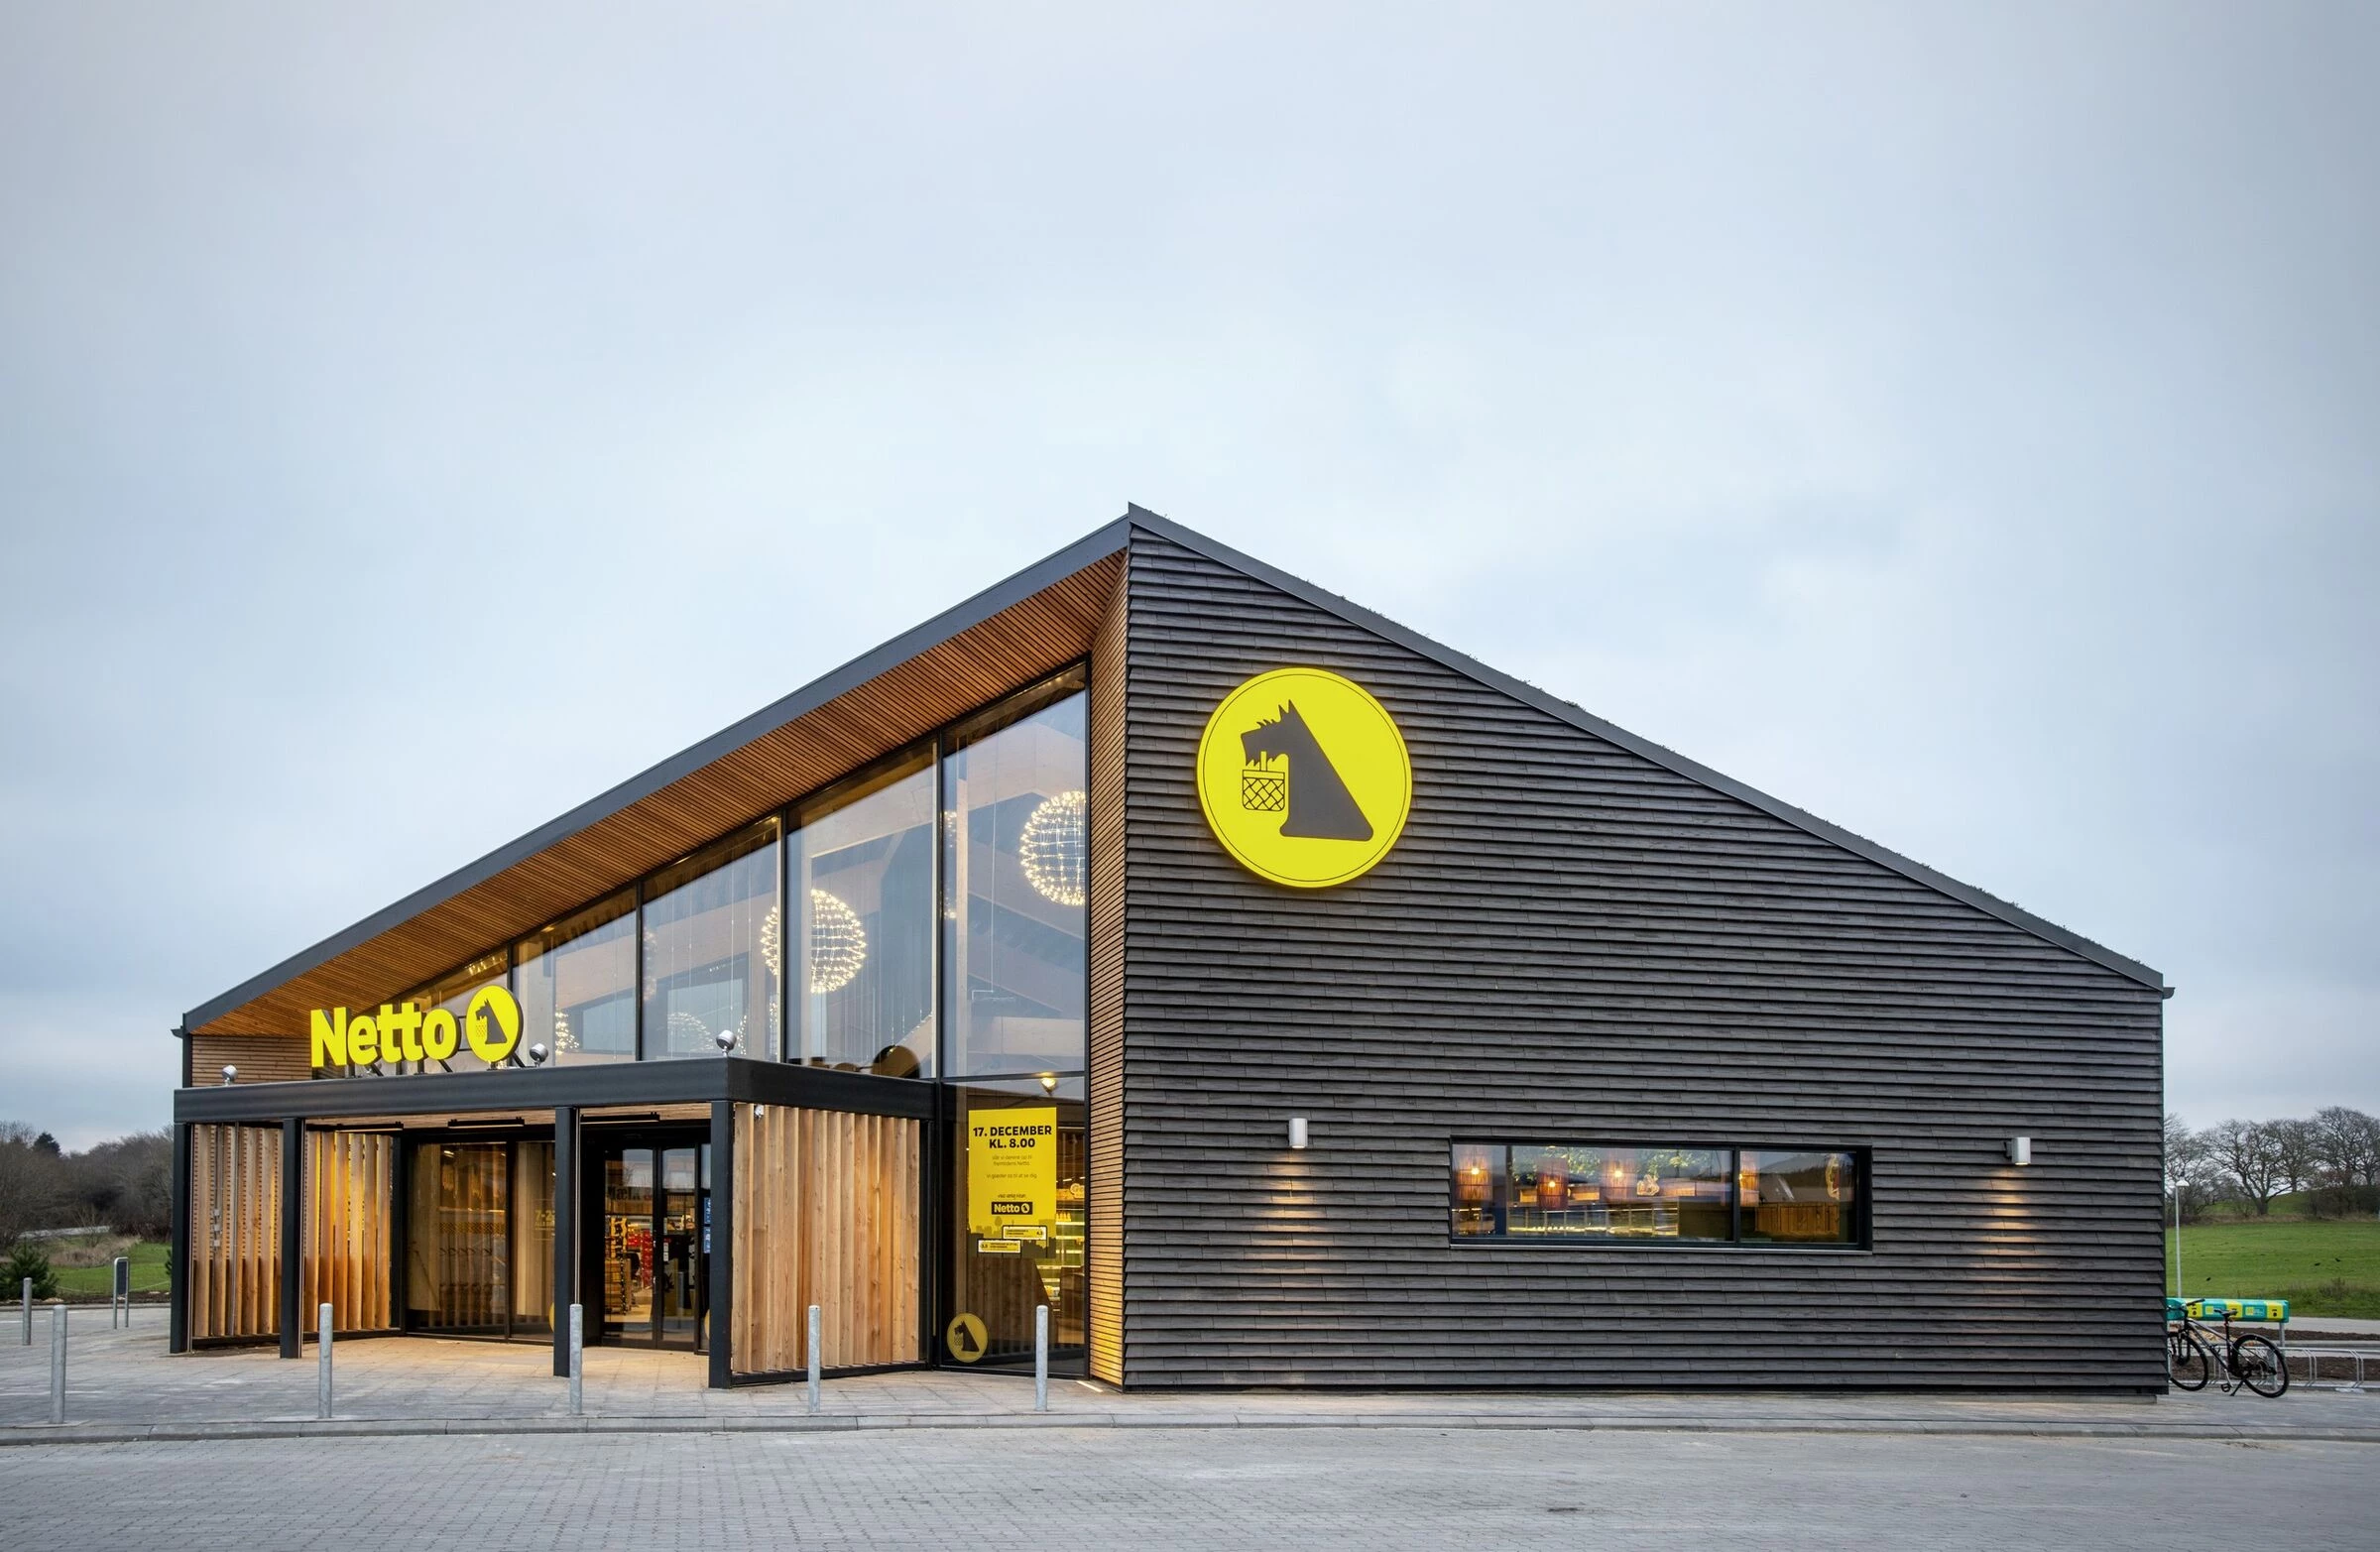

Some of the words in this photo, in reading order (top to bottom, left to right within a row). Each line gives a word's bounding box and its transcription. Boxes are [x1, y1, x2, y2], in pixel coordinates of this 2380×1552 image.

[310, 1002, 459, 1068] Netto
[973, 1127, 988, 1137] 17.
[990, 1126, 1052, 1136] DECEMBER
[989, 1138, 1007, 1148] KL.
[1010, 1137, 1036, 1148] 8.00
[994, 1203, 1020, 1213] Netto
